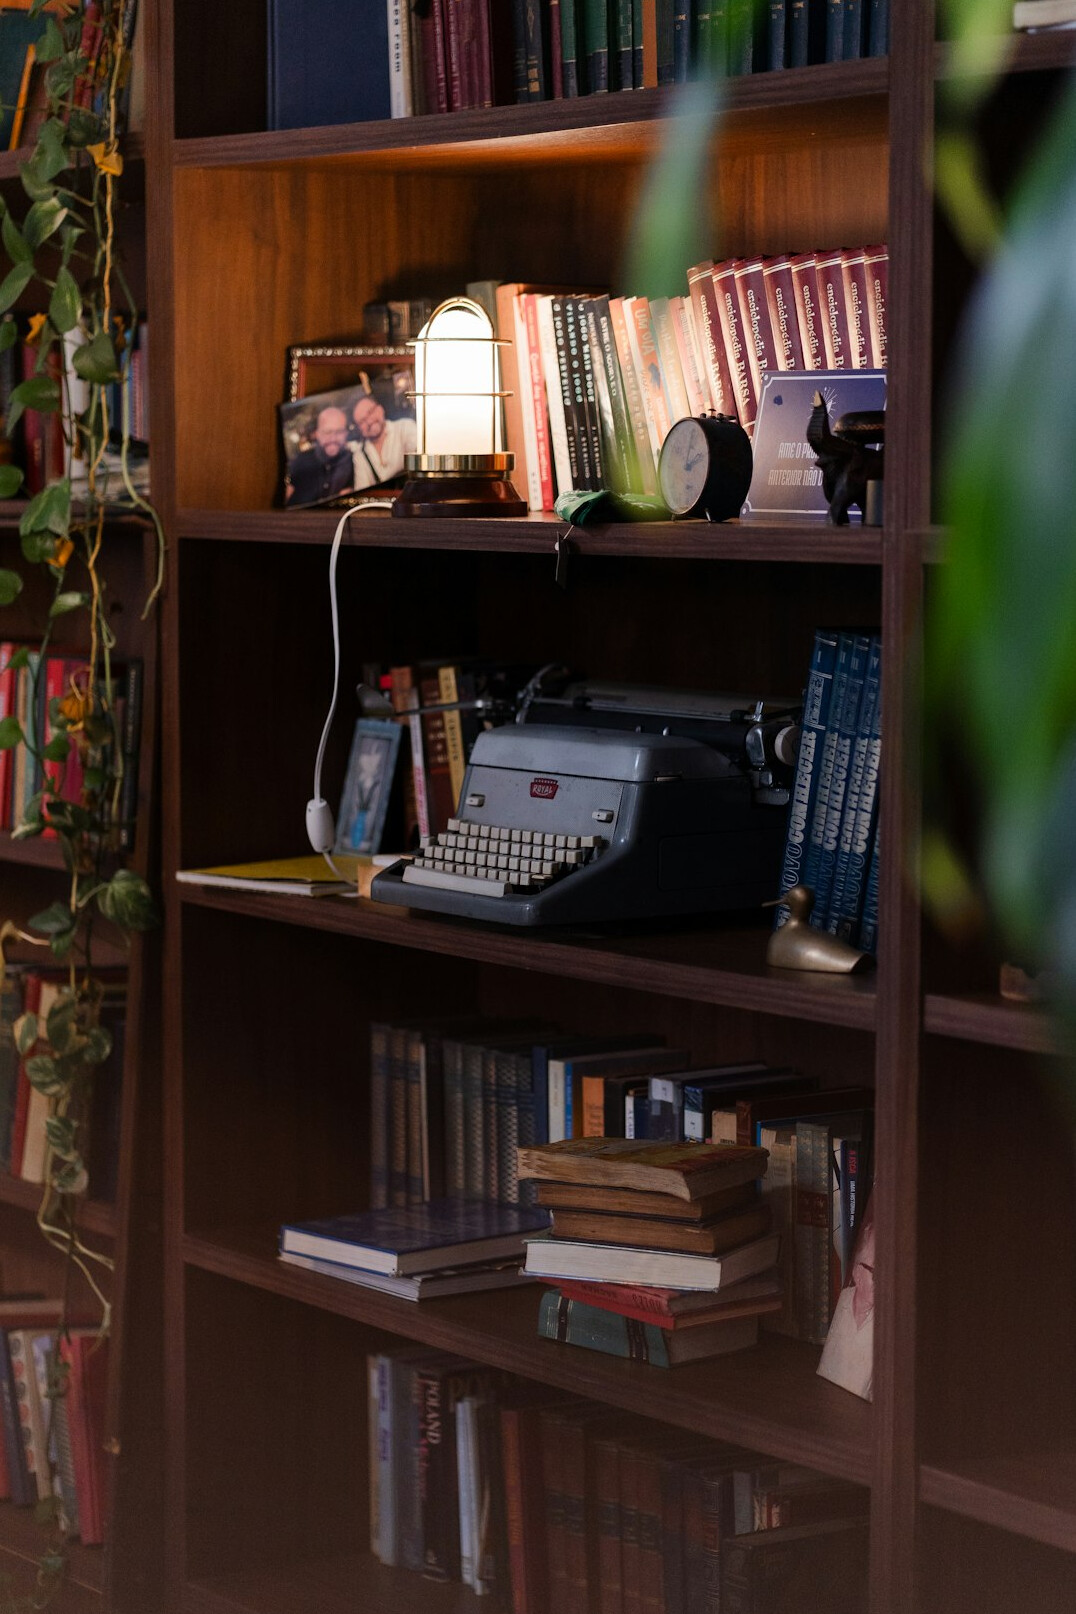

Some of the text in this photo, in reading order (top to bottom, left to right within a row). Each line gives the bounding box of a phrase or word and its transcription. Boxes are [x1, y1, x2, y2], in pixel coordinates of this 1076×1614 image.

[553, 303, 561, 311] O
[554, 316, 564, 346] JOGO
[578, 314, 588, 342] JOGO
[634, 308, 647, 329] UM
[747, 290, 764, 357] enciclopédia
[776, 287, 792, 359] enciclopédia
[803, 285, 820, 355] enciclopédia
[827, 283, 842, 355] enciclopédia
[851, 281, 866, 355] enciclopédia
[566, 303, 583, 403] VIRANDO O JOGO
[582, 344, 592, 371] MAIS
[600, 316, 610, 344] ENTRE
[606, 353, 615, 381] AGORA
[725, 292, 750, 406] enciclopédia BARSA
[559, 350, 571, 406] PERFEITO
[585, 373, 595, 402] DOCE
[711, 361, 724, 406] BARSA
[569, 436, 578, 478] STERLING
[581, 436, 590, 478] STERLING
[593, 436, 601, 478] STERLING
[768, 470, 802, 486] ANTERIOR
[803, 466, 817, 486] NÃO
[778, 442, 795, 459] AME
[532, 784, 553, 795] ROYAL
[788, 730, 817, 844] CONHECER
[811, 732, 838, 845] CONHECER
[823, 737, 851, 851] CONHECER
[841, 737, 868, 853] CONHECER
[851, 738, 881, 853] CONHECER
